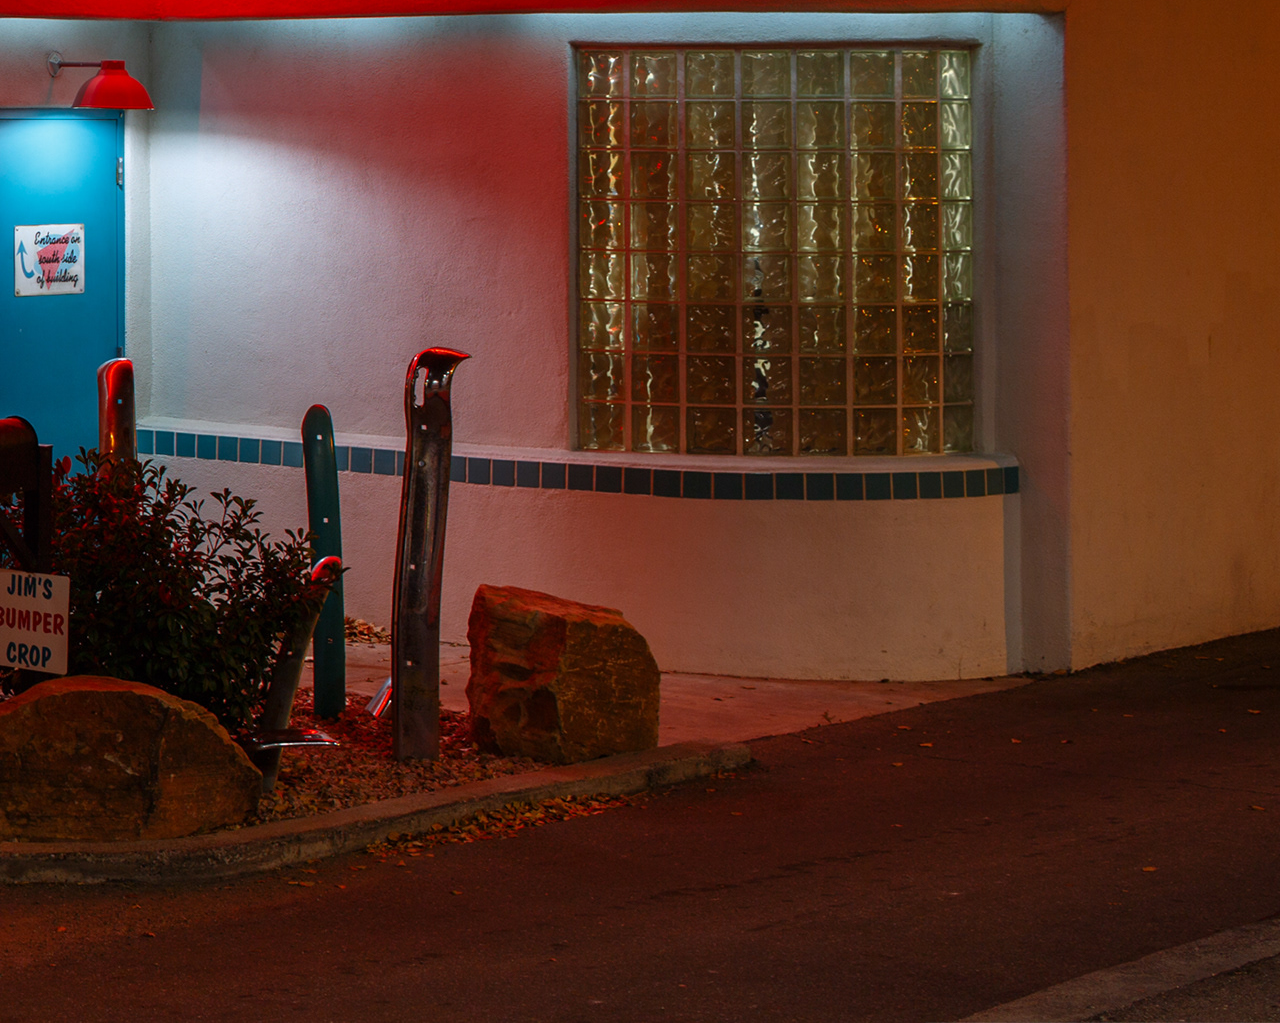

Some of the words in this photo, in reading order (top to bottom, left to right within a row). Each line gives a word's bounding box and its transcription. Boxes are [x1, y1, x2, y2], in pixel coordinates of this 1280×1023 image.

[35, 232, 70, 245] Entrance
[71, 236, 81, 244] on
[39, 251, 60, 264] south
[61, 250, 77, 263] side
[37, 270, 45, 289] of
[47, 269, 78, 287] building
[7, 574, 53, 599] JIM'S
[7, 642, 52, 668] CROP
